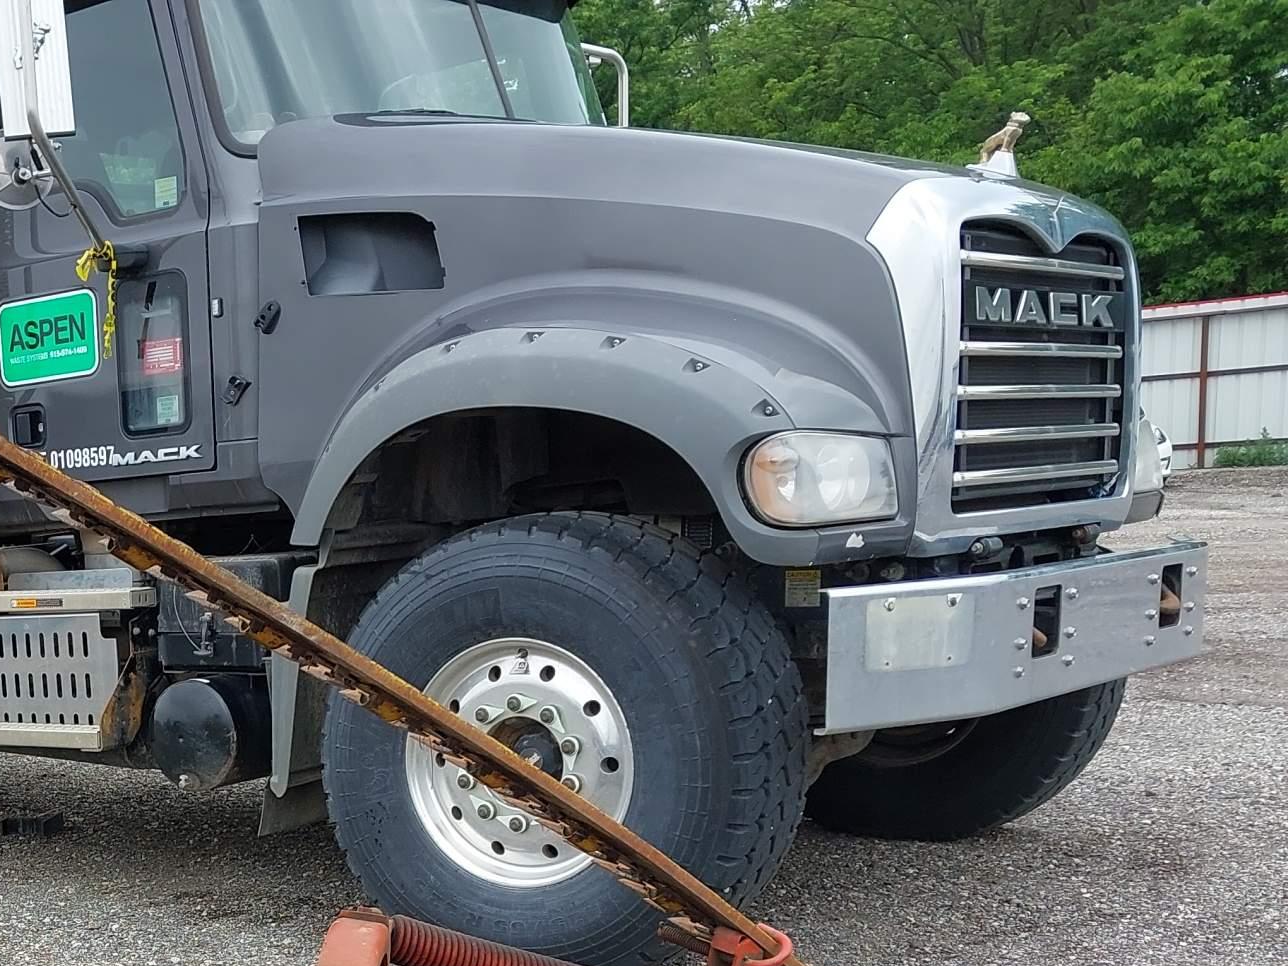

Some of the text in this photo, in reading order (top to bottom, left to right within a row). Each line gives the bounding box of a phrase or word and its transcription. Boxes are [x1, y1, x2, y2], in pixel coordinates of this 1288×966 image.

[975, 286, 1114, 327] MACK
[9, 311, 86, 352] ASPEN
[50, 445, 114, 469] 01098597
[113, 444, 203, 466] MACK
